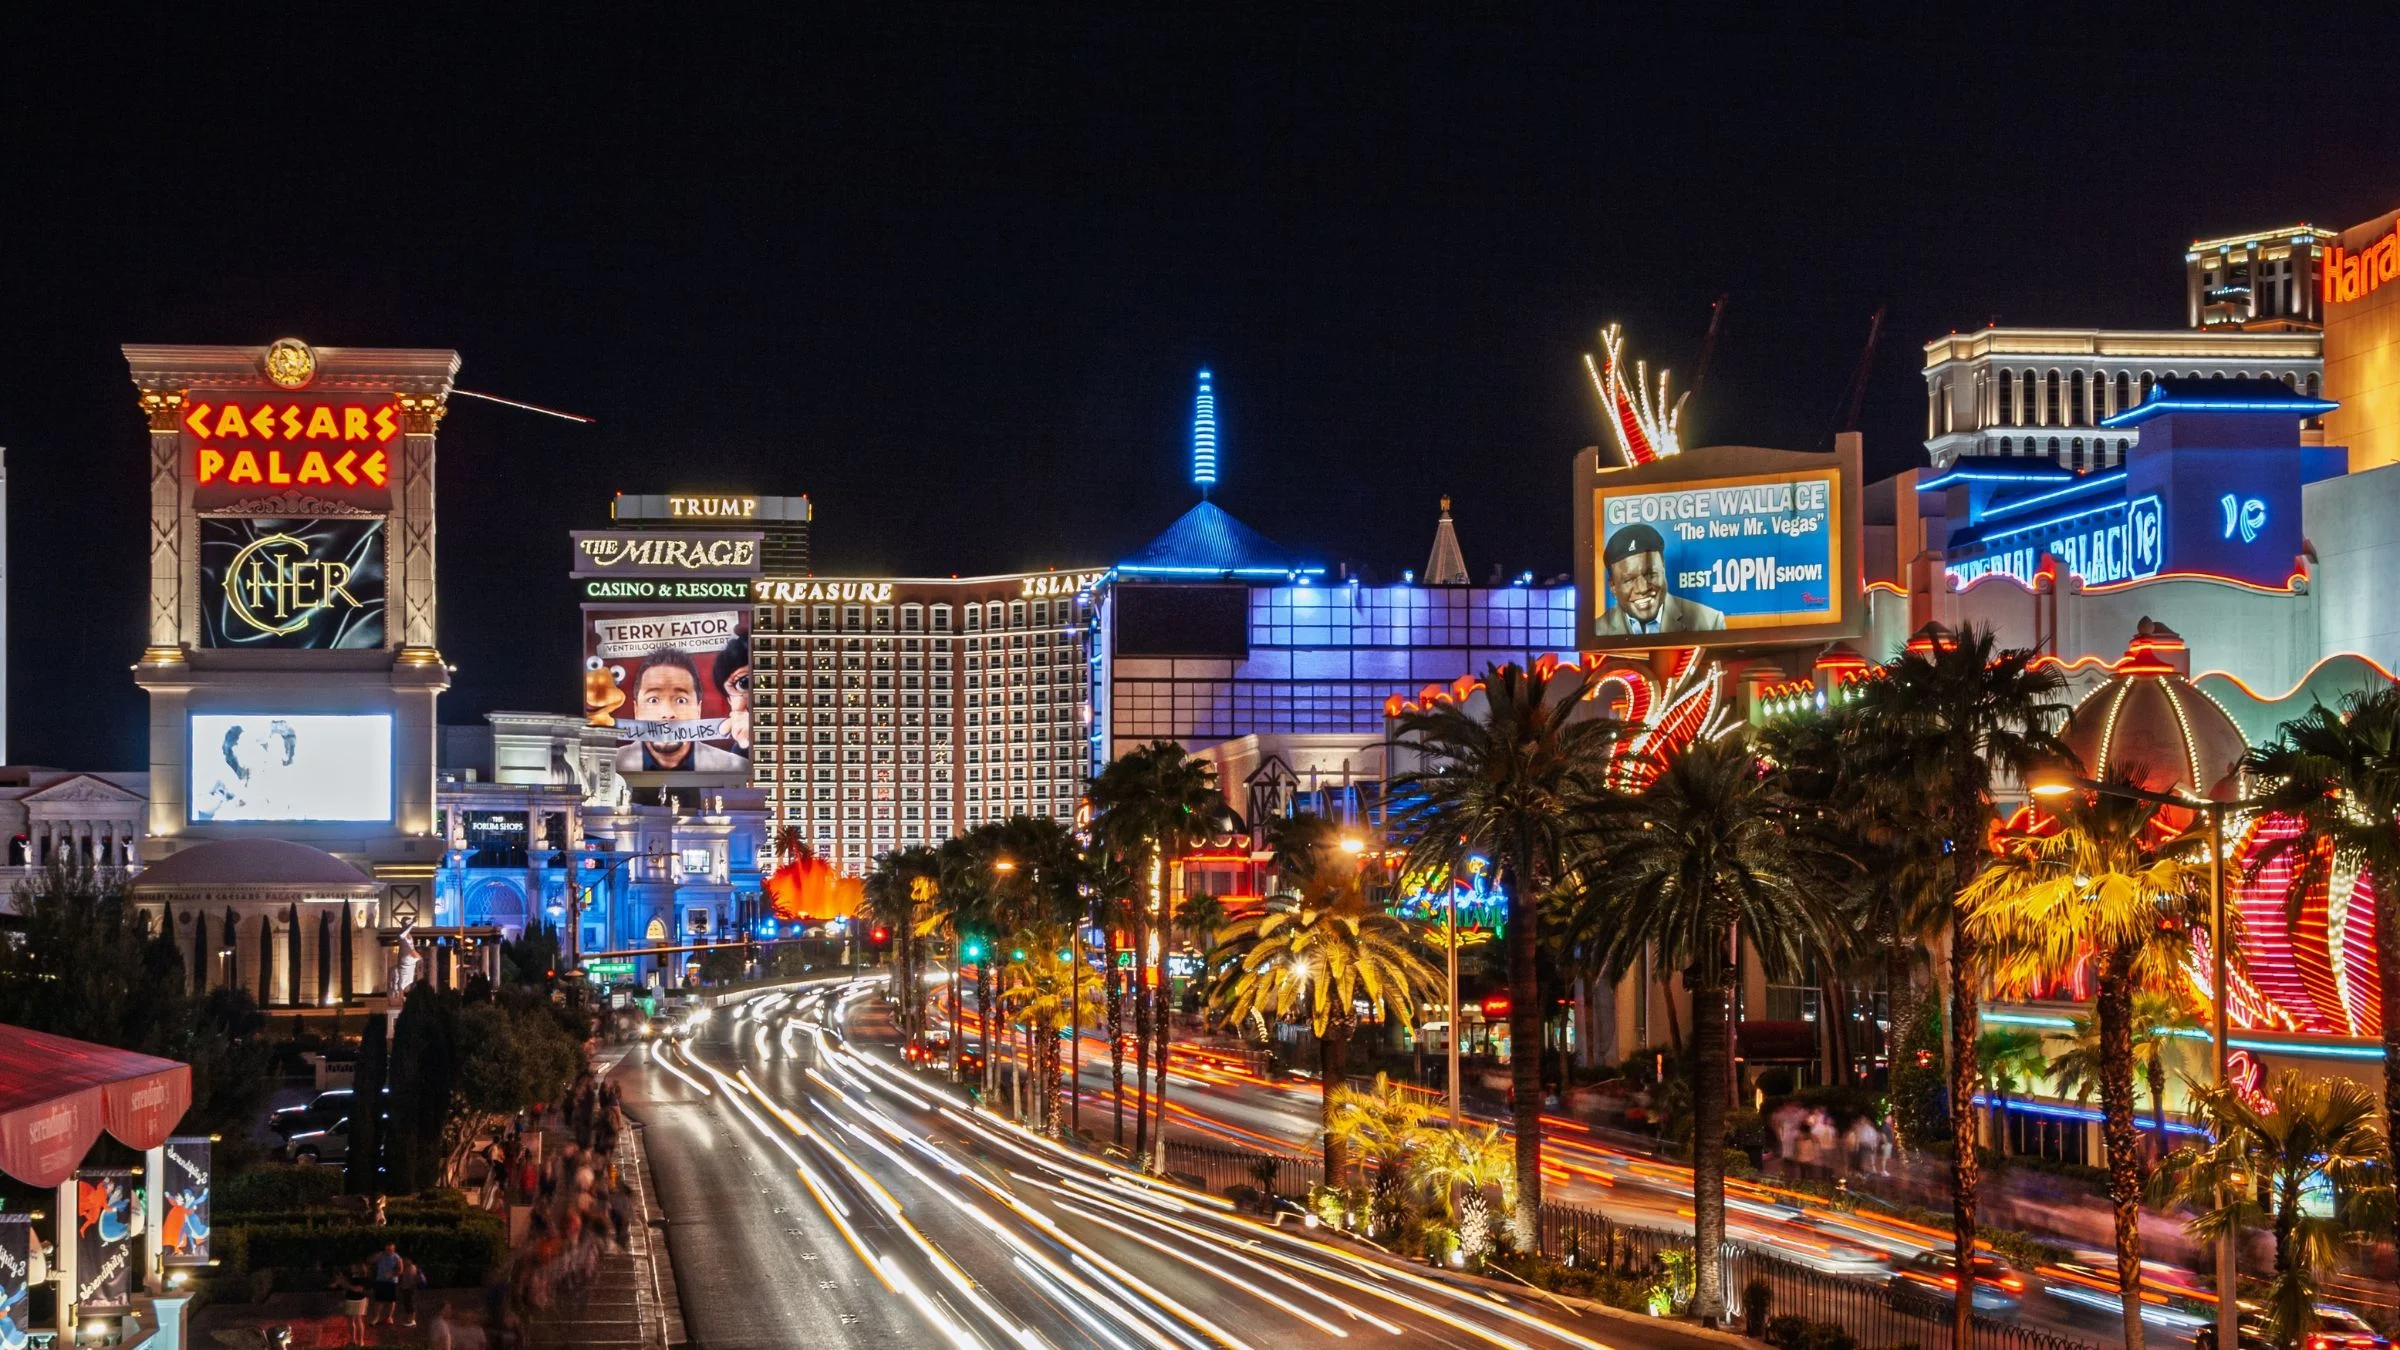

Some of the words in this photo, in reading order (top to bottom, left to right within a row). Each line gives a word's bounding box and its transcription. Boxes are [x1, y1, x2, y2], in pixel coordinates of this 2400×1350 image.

[2323, 217, 2400, 303] Harra
[186, 404, 397, 442] CAESARS
[199, 449, 388, 487] PALACE
[670, 498, 756, 516] TRUMP
[1608, 492, 1711, 525] GEORGE
[1717, 484, 1826, 516] WALLACE
[1673, 521, 1705, 541] “The
[1709, 519, 1740, 539] New
[1743, 518, 1768, 537] Mr.
[1771, 513, 1825, 538] Vegas”
[580, 540, 619, 555] THE
[595, 540, 754, 568] MIRAGE
[2050, 524, 2128, 586] PALAC
[222, 533, 363, 637] CHER
[1679, 570, 1712, 589] BEST
[1711, 557, 1776, 593] 10PM
[1776, 563, 1823, 583] SHOW!
[587, 582, 654, 598] CASINO
[658, 583, 673, 598] &
[676, 582, 748, 598] RESORT
[755, 583, 893, 602] TREASURE
[605, 623, 664, 641] TERRY
[671, 619, 728, 637] FATOR
[606, 642, 677, 652] VENTRILOQUISM
[687, 637, 729, 647] CONCERT
[674, 727, 687, 740] NO
[472, 822, 499, 830] FORUM
[500, 823, 523, 831] SHOPS
[120, 1243, 129, 1257] 3
[17, 1260, 26, 1277] 3
